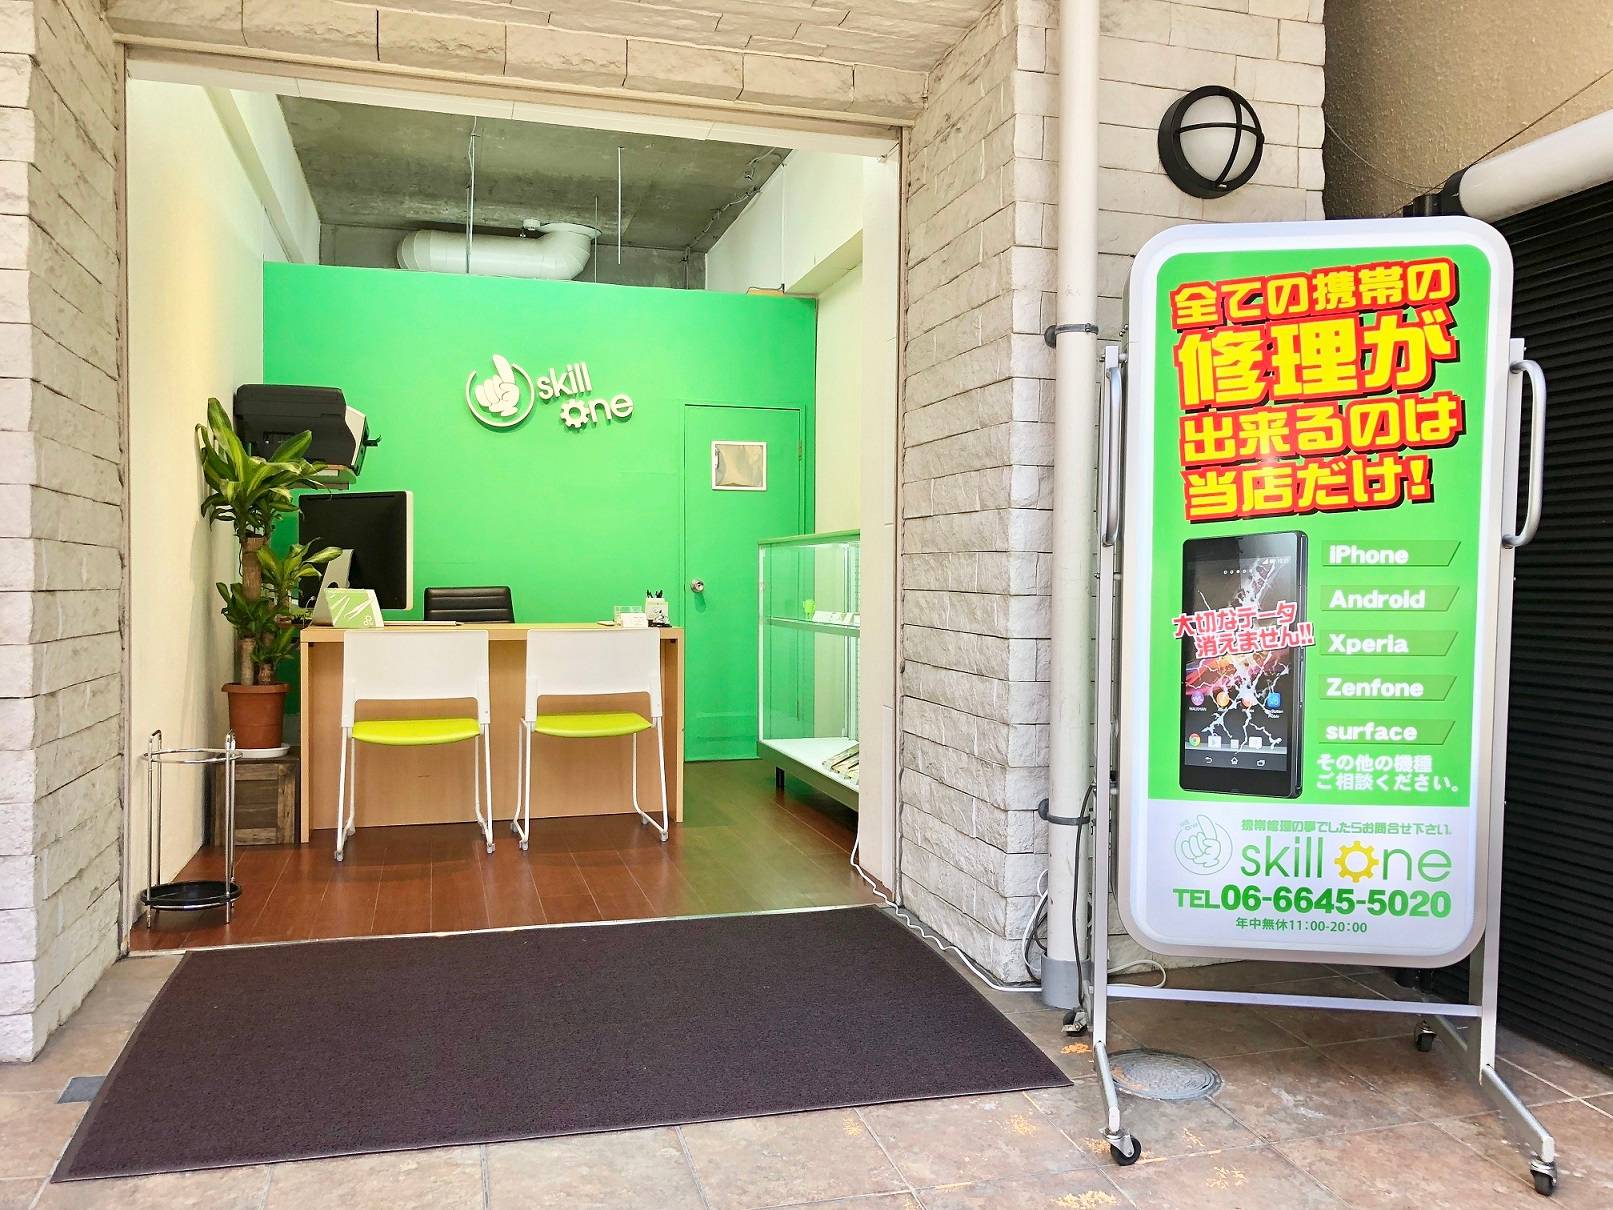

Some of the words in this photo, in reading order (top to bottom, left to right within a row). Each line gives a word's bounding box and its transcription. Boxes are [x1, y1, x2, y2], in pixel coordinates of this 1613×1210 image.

[1172, 259, 1455, 327] 全ての携帯の
[1175, 308, 1455, 407] 修理が
[537, 362, 593, 400] skill
[1181, 393, 1461, 464] 出来るのは
[1184, 456, 1431, 519] 当店だけ!
[1328, 544, 1410, 565] iPhone
[1328, 589, 1426, 609] Android
[1173, 602, 1298, 637] 大切なデータ
[1327, 633, 1409, 655] Xperia
[1326, 677, 1424, 697] Zenfone
[1325, 722, 1418, 741] surface
[1316, 754, 1433, 773] その他の機種
[1315, 773, 1459, 792] ご相談ください。
[1240, 835, 1324, 879] skill
